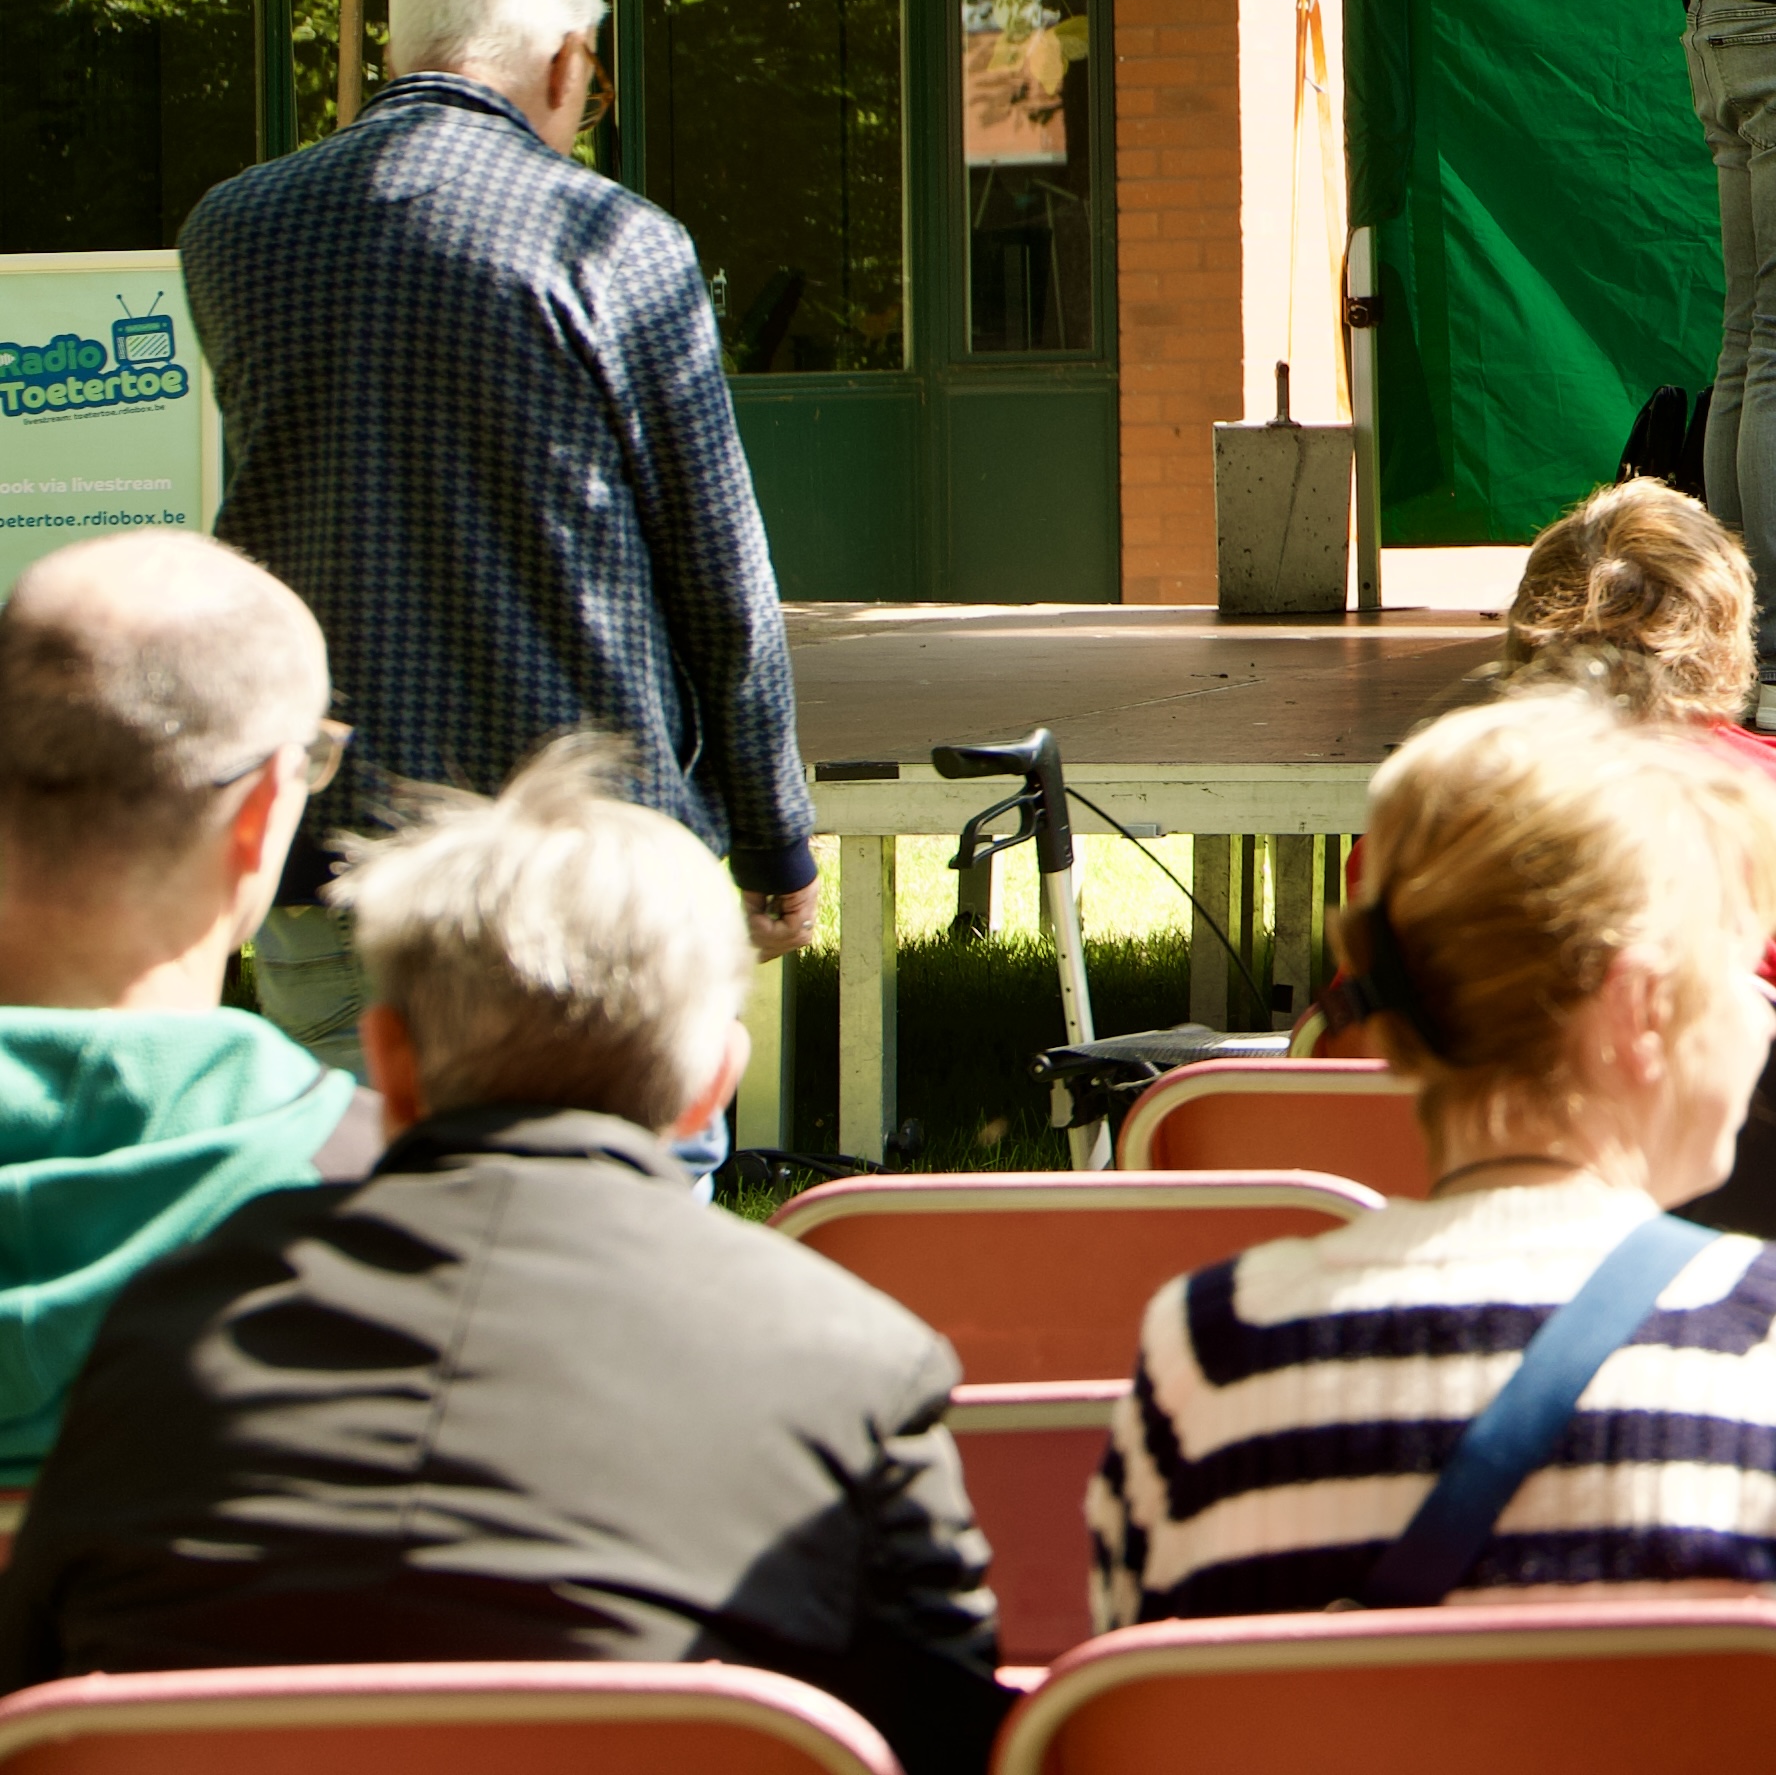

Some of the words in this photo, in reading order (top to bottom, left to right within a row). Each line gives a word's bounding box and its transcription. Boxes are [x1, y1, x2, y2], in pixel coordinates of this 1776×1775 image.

[0, 340, 102, 377] Radio
[0, 370, 184, 411] Toetertoe
[0, 478, 36, 494] ook
[39, 477, 68, 493] via
[71, 476, 172, 492] livestream
